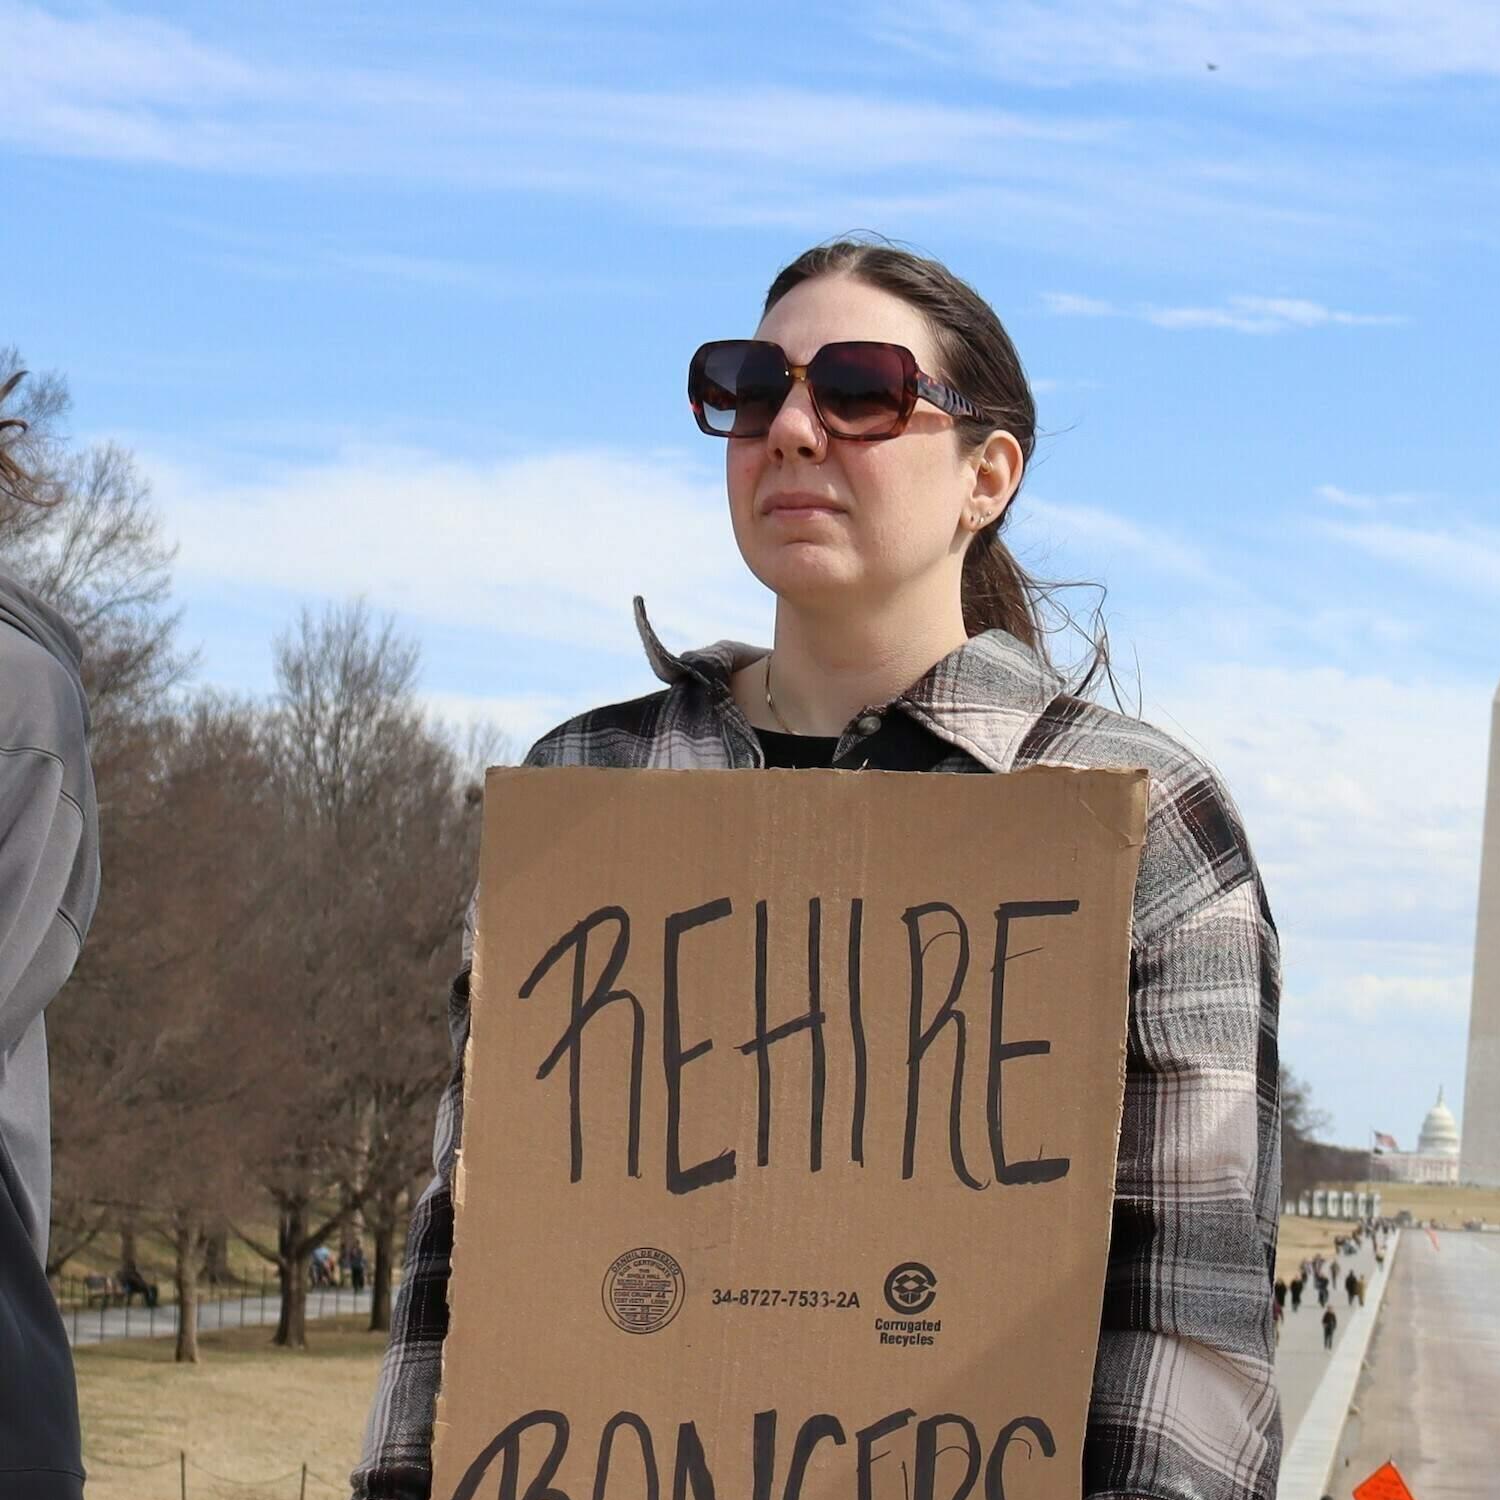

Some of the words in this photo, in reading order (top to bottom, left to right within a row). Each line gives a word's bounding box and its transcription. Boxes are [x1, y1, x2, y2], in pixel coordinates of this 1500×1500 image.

[518, 896, 1080, 1195] REHIRE
[711, 1288, 861, 1309] 34-8727-7533-2A
[874, 1318, 942, 1334] Corrugated
[879, 1332, 934, 1347] Recycles
